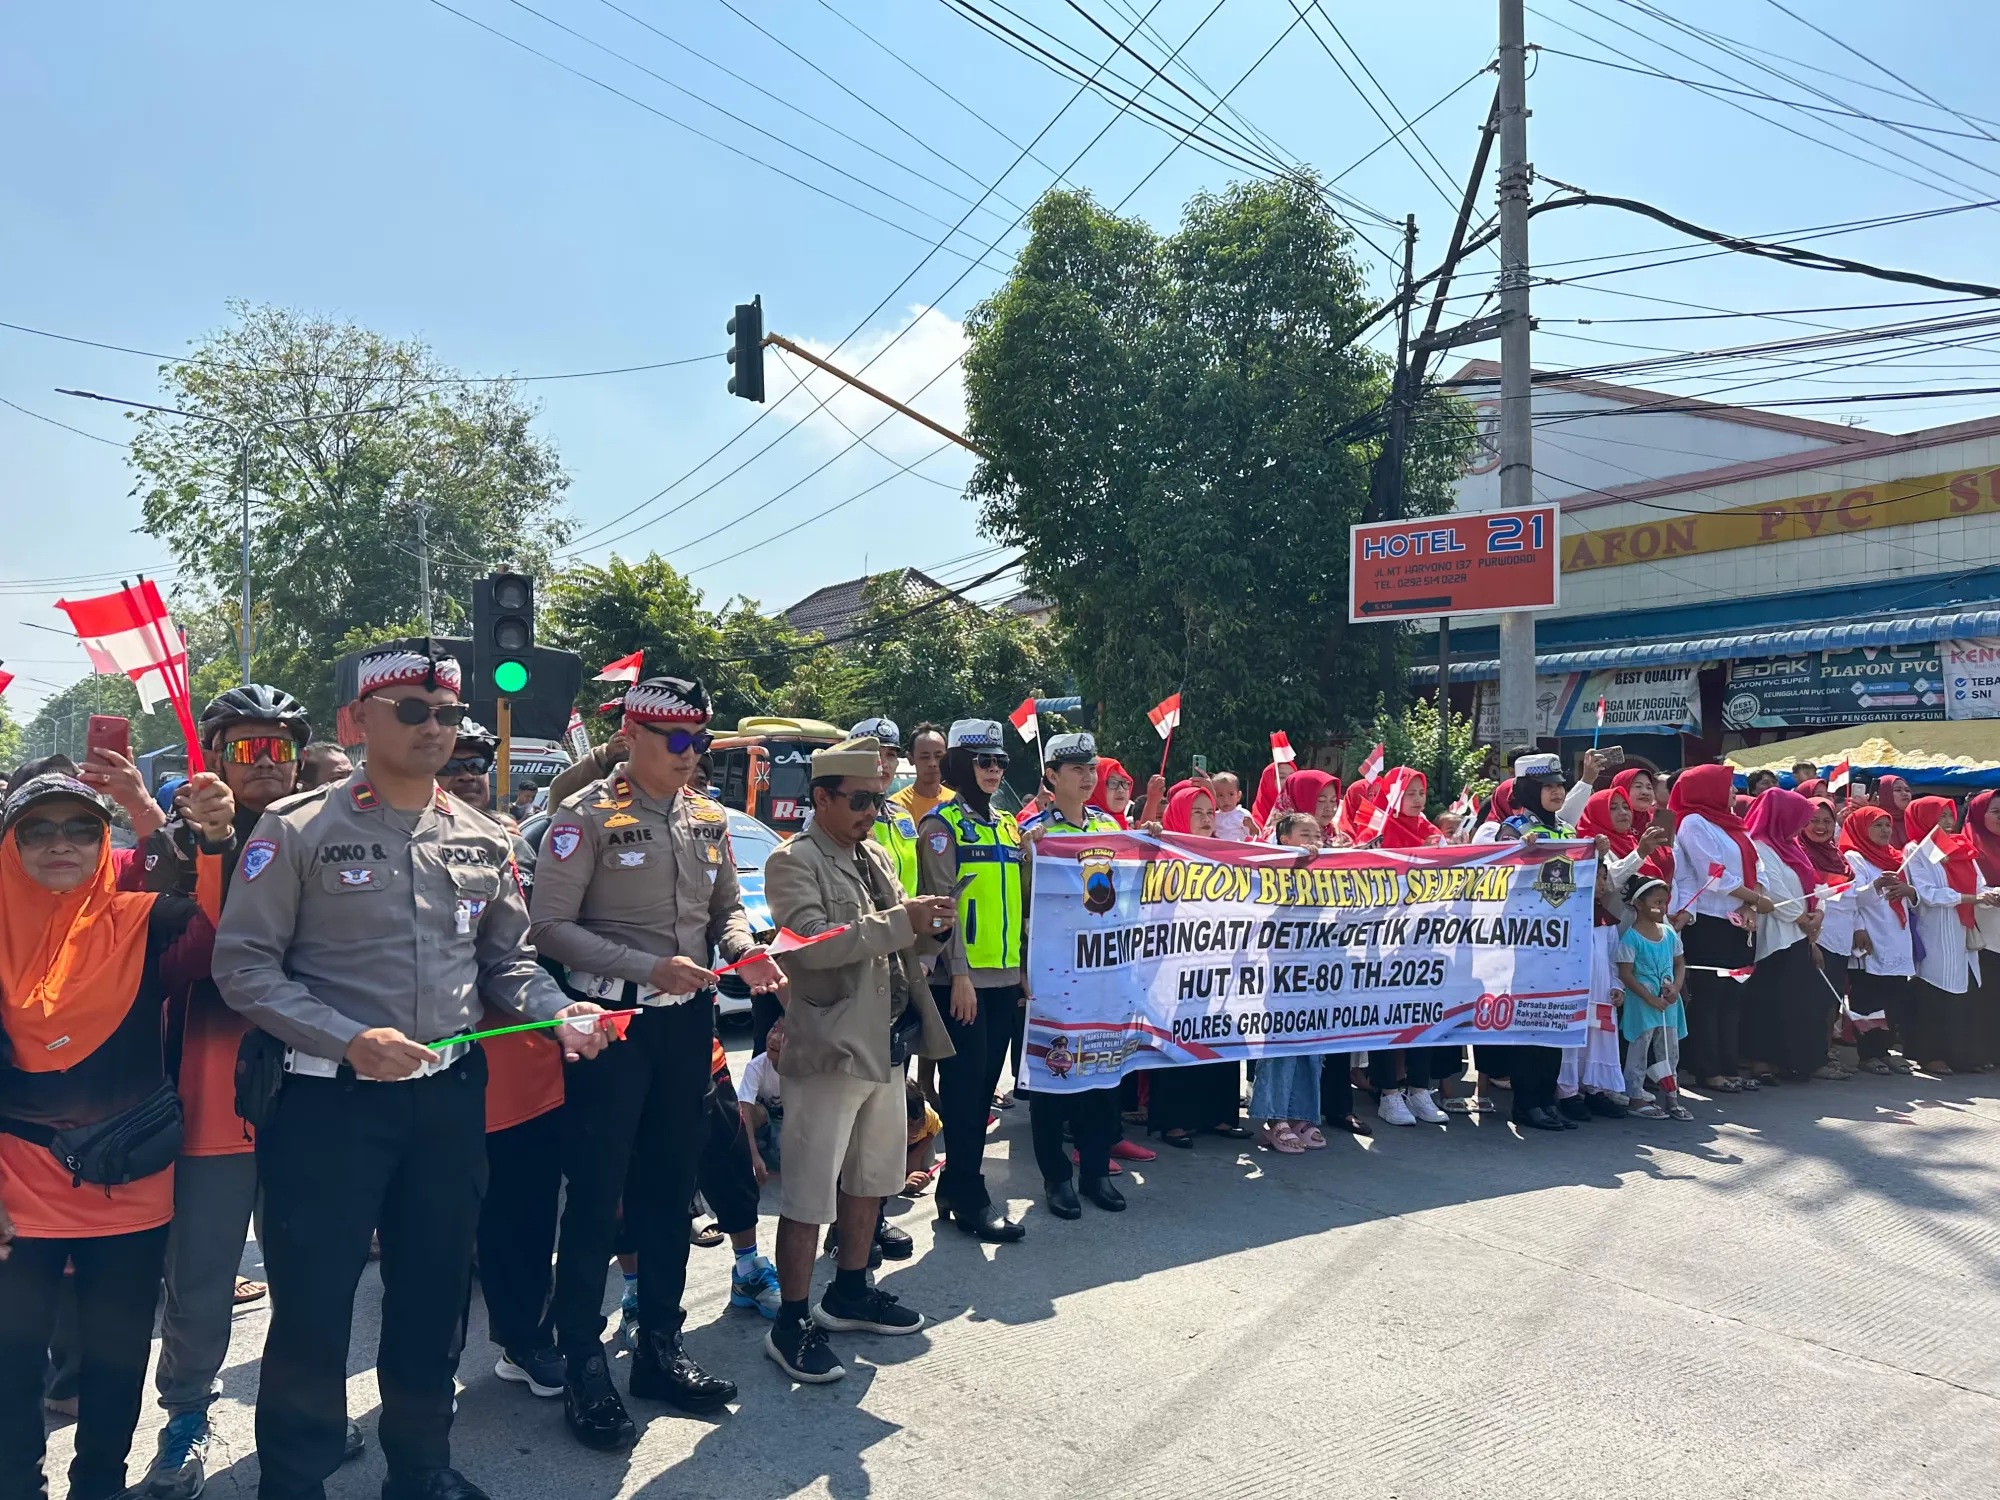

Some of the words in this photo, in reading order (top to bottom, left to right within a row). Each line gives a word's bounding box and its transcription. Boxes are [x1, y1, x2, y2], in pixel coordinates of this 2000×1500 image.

[1364, 528, 1465, 561] HOTEL
[1487, 514, 1544, 553] 21
[1560, 518, 1697, 571] AFON
[1757, 491, 1874, 541] PVC
[1405, 561, 1452, 574] HARYONO
[1456, 559, 1473, 570] 137
[1478, 554, 1536, 568] PURWODADI
[1397, 576, 1422, 588] 0292
[1423, 575, 1439, 586] 514
[1442, 574, 1467, 585] 0228
[1615, 670, 1643, 685] BEST
[1644, 668, 1692, 684] QUALITY
[1820, 663, 1895, 679] PLAFON
[1899, 660, 1939, 674] PVC
[1729, 681, 1761, 690] PLAFON
[1781, 677, 1811, 685] SUPER
[1764, 689, 1810, 698] KEUNGGULAN
[1971, 690, 1992, 699] SNI
[1732, 707, 1754, 717] CHOICE
[1733, 701, 1752, 709] BEST
[1601, 711, 1641, 724] RODUK
[1643, 708, 1688, 722] JAVAFON
[1805, 715, 1839, 724] EFEKTIF
[1842, 713, 1897, 722] PENGGANTI
[1901, 712, 1943, 720] GYPSUM
[608, 828, 653, 845] ARIE
[321, 844, 365, 863] JOKO
[1140, 859, 1251, 906] MOHON
[1255, 866, 1400, 908] BERHENTI
[1403, 865, 1516, 905] SEJENAK
[1077, 919, 1251, 969] MEMPERINGATI
[1257, 917, 1411, 949] DETIK-DETIK
[1412, 917, 1570, 948] PROKLAMASI
[1178, 967, 1231, 1001] HUT
[1239, 966, 1264, 995] RI
[1273, 963, 1344, 993] KE-80
[1351, 959, 1445, 989] TH.2025
[1474, 993, 1515, 1031] 80
[1518, 1000, 1547, 1009] Bersatu
[1172, 1013, 1232, 1044] POLRES
[1237, 1008, 1328, 1036] GROBOGAN
[1332, 1004, 1379, 1030] POLDA
[1384, 1002, 1444, 1026] JATENG
[1516, 1010, 1542, 1019] Rakyat
[1514, 1019, 1549, 1028] Indonesia
[1551, 1021, 1568, 1031] Maju
